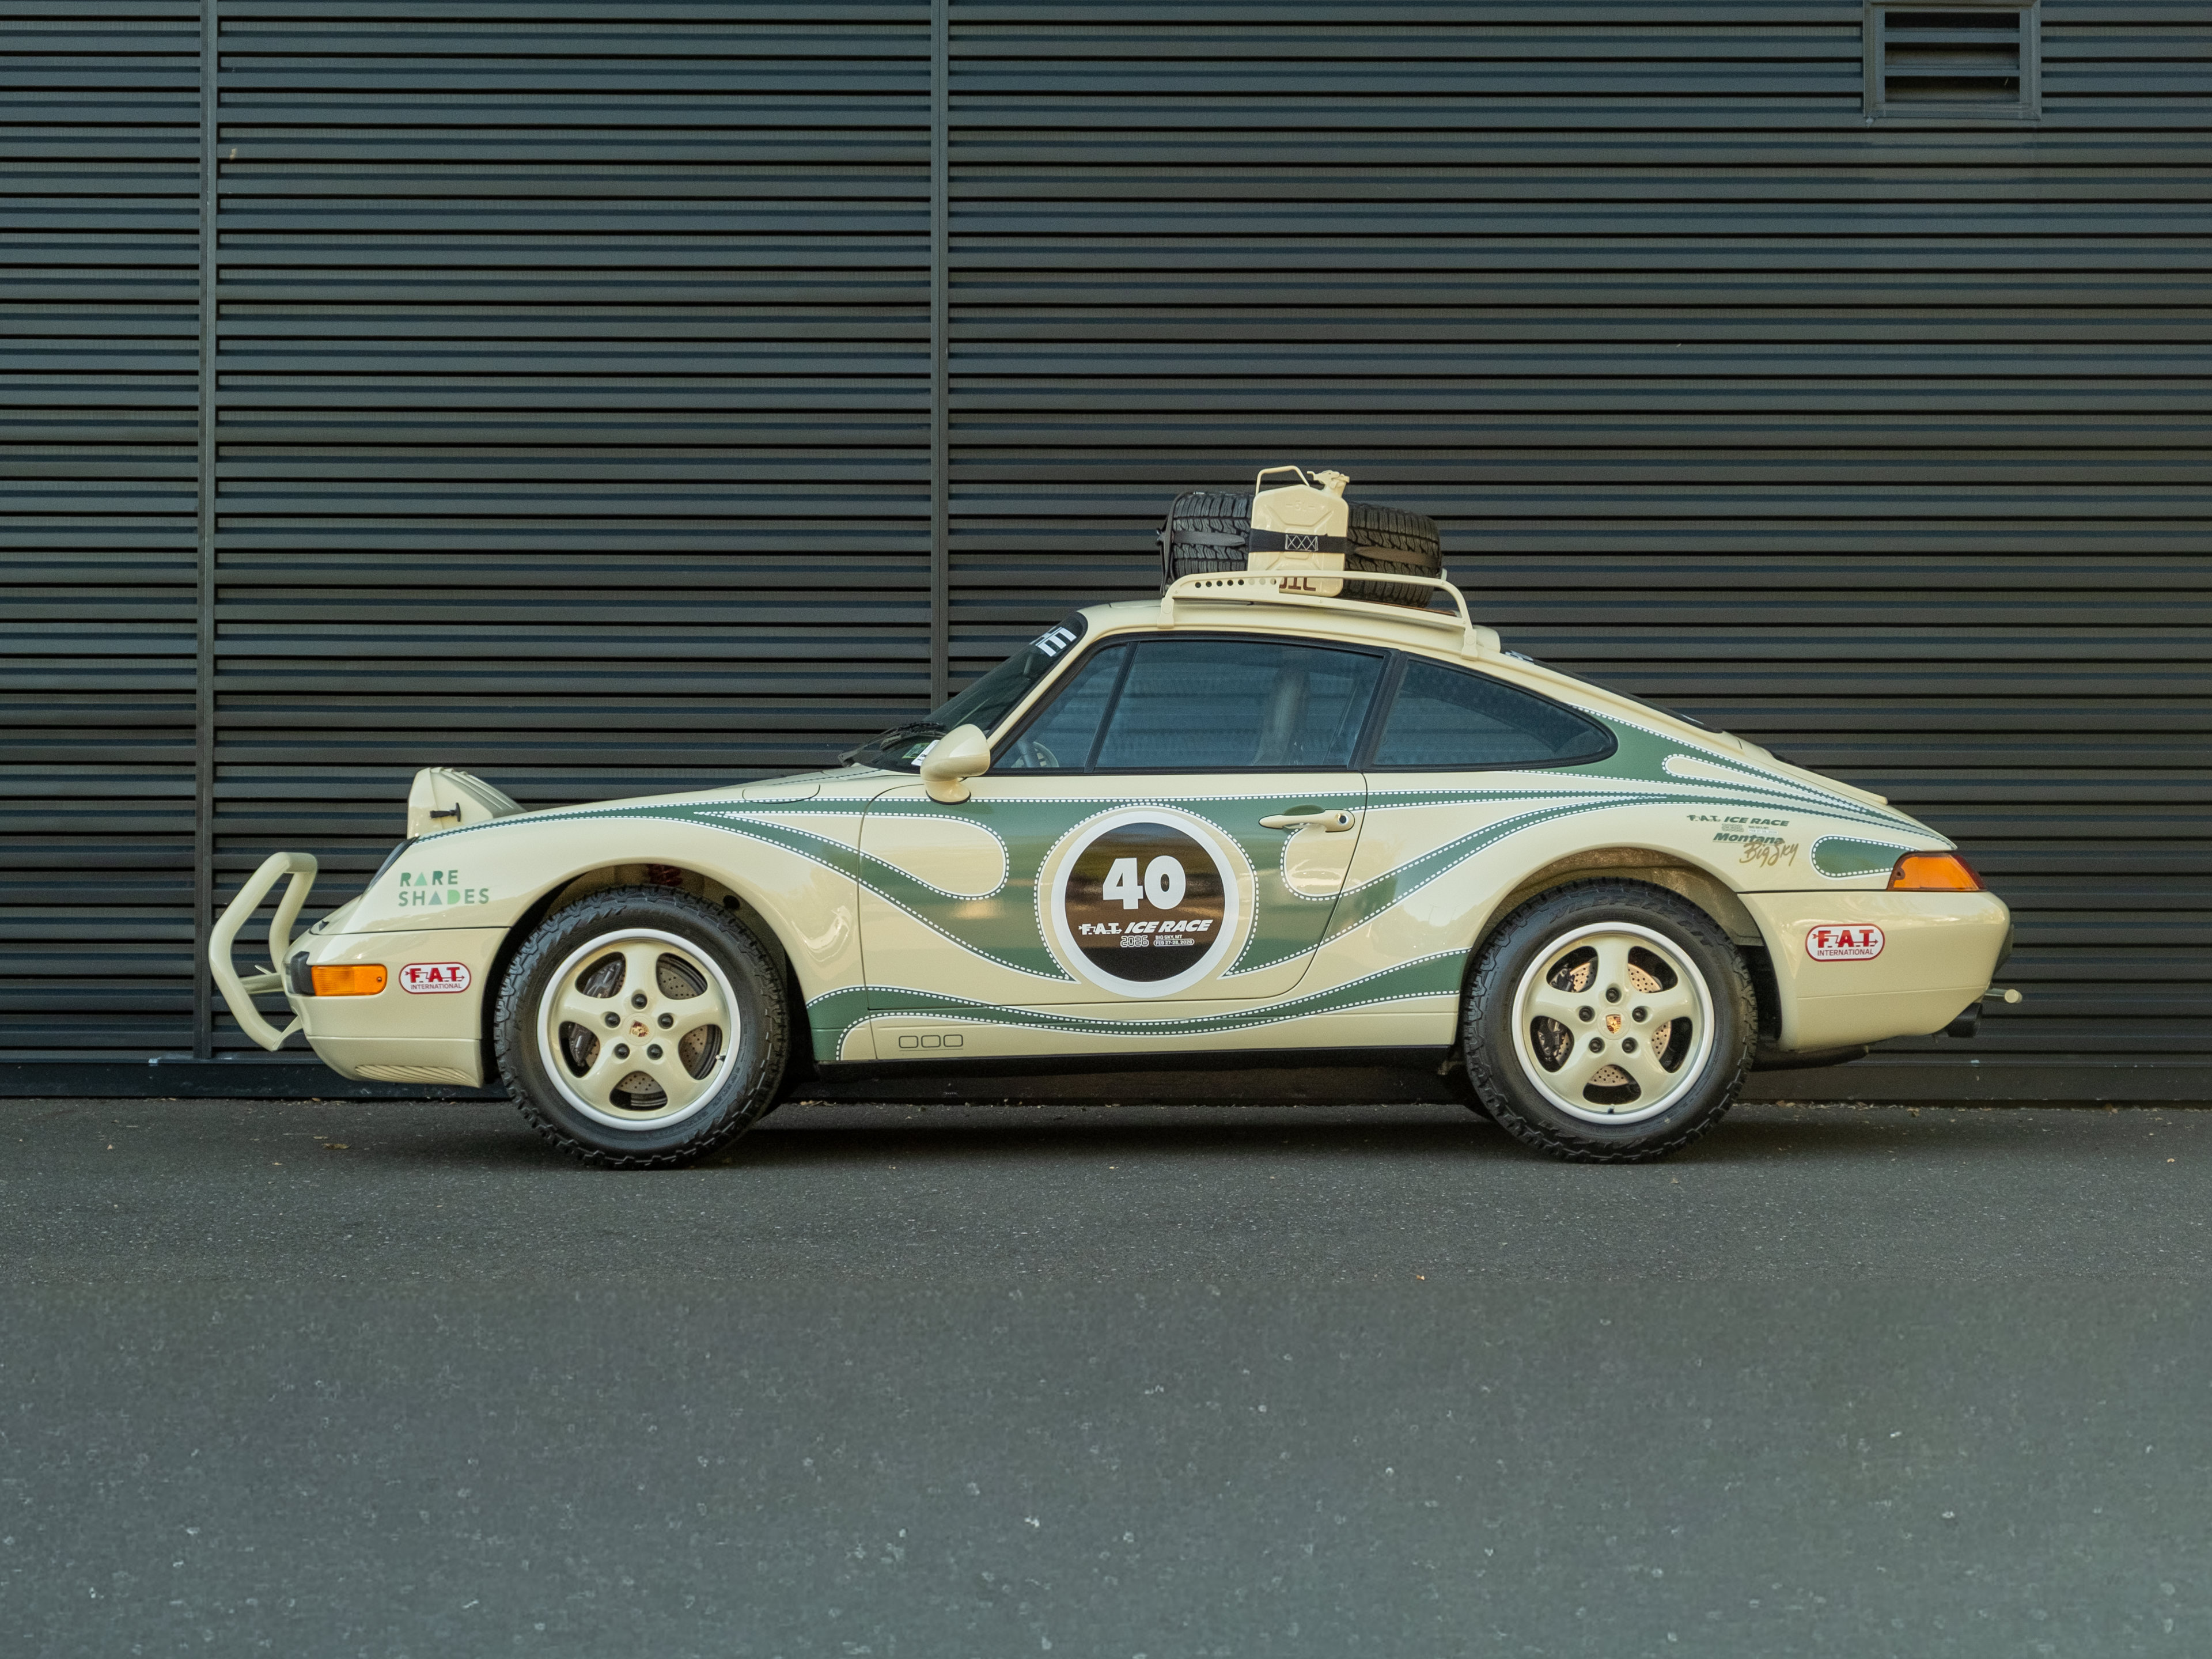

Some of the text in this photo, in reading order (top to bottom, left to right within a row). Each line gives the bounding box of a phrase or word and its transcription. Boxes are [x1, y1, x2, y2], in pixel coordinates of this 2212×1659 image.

[1724, 816, 1749, 824] ICE
[1750, 817, 1790, 827] RACE
[1713, 832, 1785, 845] Montana
[1739, 840, 1770, 868] Big
[399, 869, 459, 887] RARE
[1102, 855, 1186, 910] 40
[398, 888, 489, 907] SHADES
[1124, 921, 1160, 934] ICE
[1158, 919, 1213, 933] RACE
[1120, 935, 1149, 948] 2026
[1817, 948, 1874, 956] INTERNATIONAL
